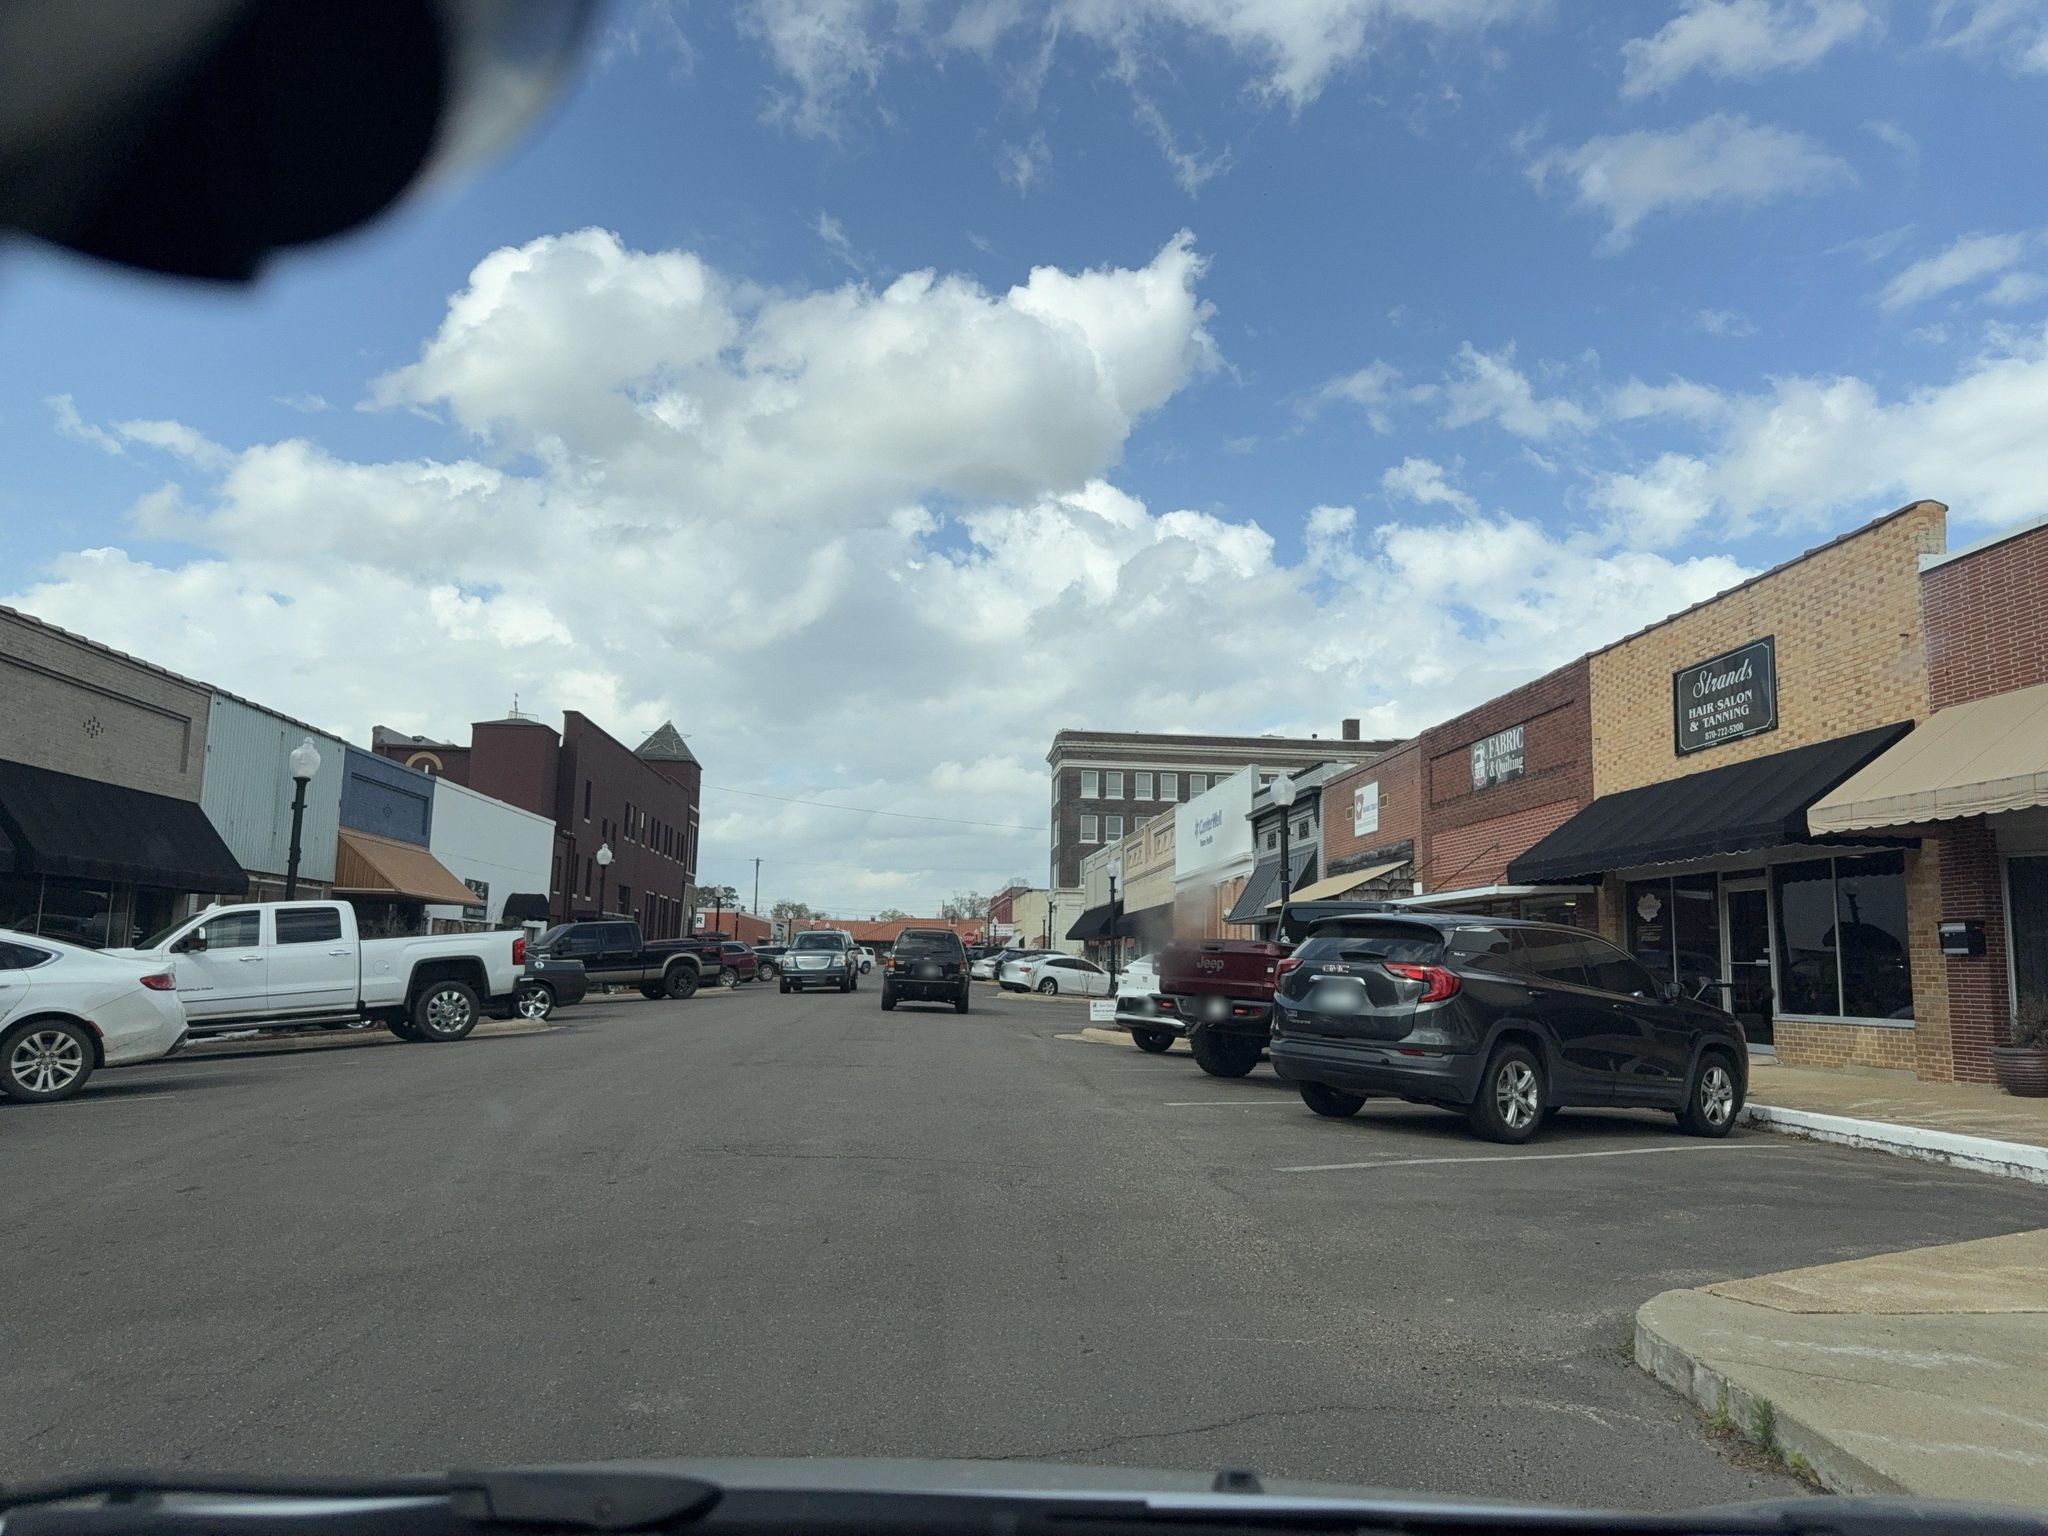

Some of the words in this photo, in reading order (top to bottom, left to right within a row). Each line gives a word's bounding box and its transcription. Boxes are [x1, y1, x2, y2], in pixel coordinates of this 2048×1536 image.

[1692, 658, 1753, 699] Strands
[1689, 721, 1699, 732] &
[1702, 704, 1750, 728] TANNING
[1704, 722, 1744, 740] 870-722-5200
[1488, 727, 1524, 759] FABRIC
[1488, 760, 1496, 778] &
[1495, 755, 1524, 779] Quilting
[696, 916, 703, 925] R
[1197, 956, 1225, 971] Jeep
[1321, 964, 1350, 974] GMC
